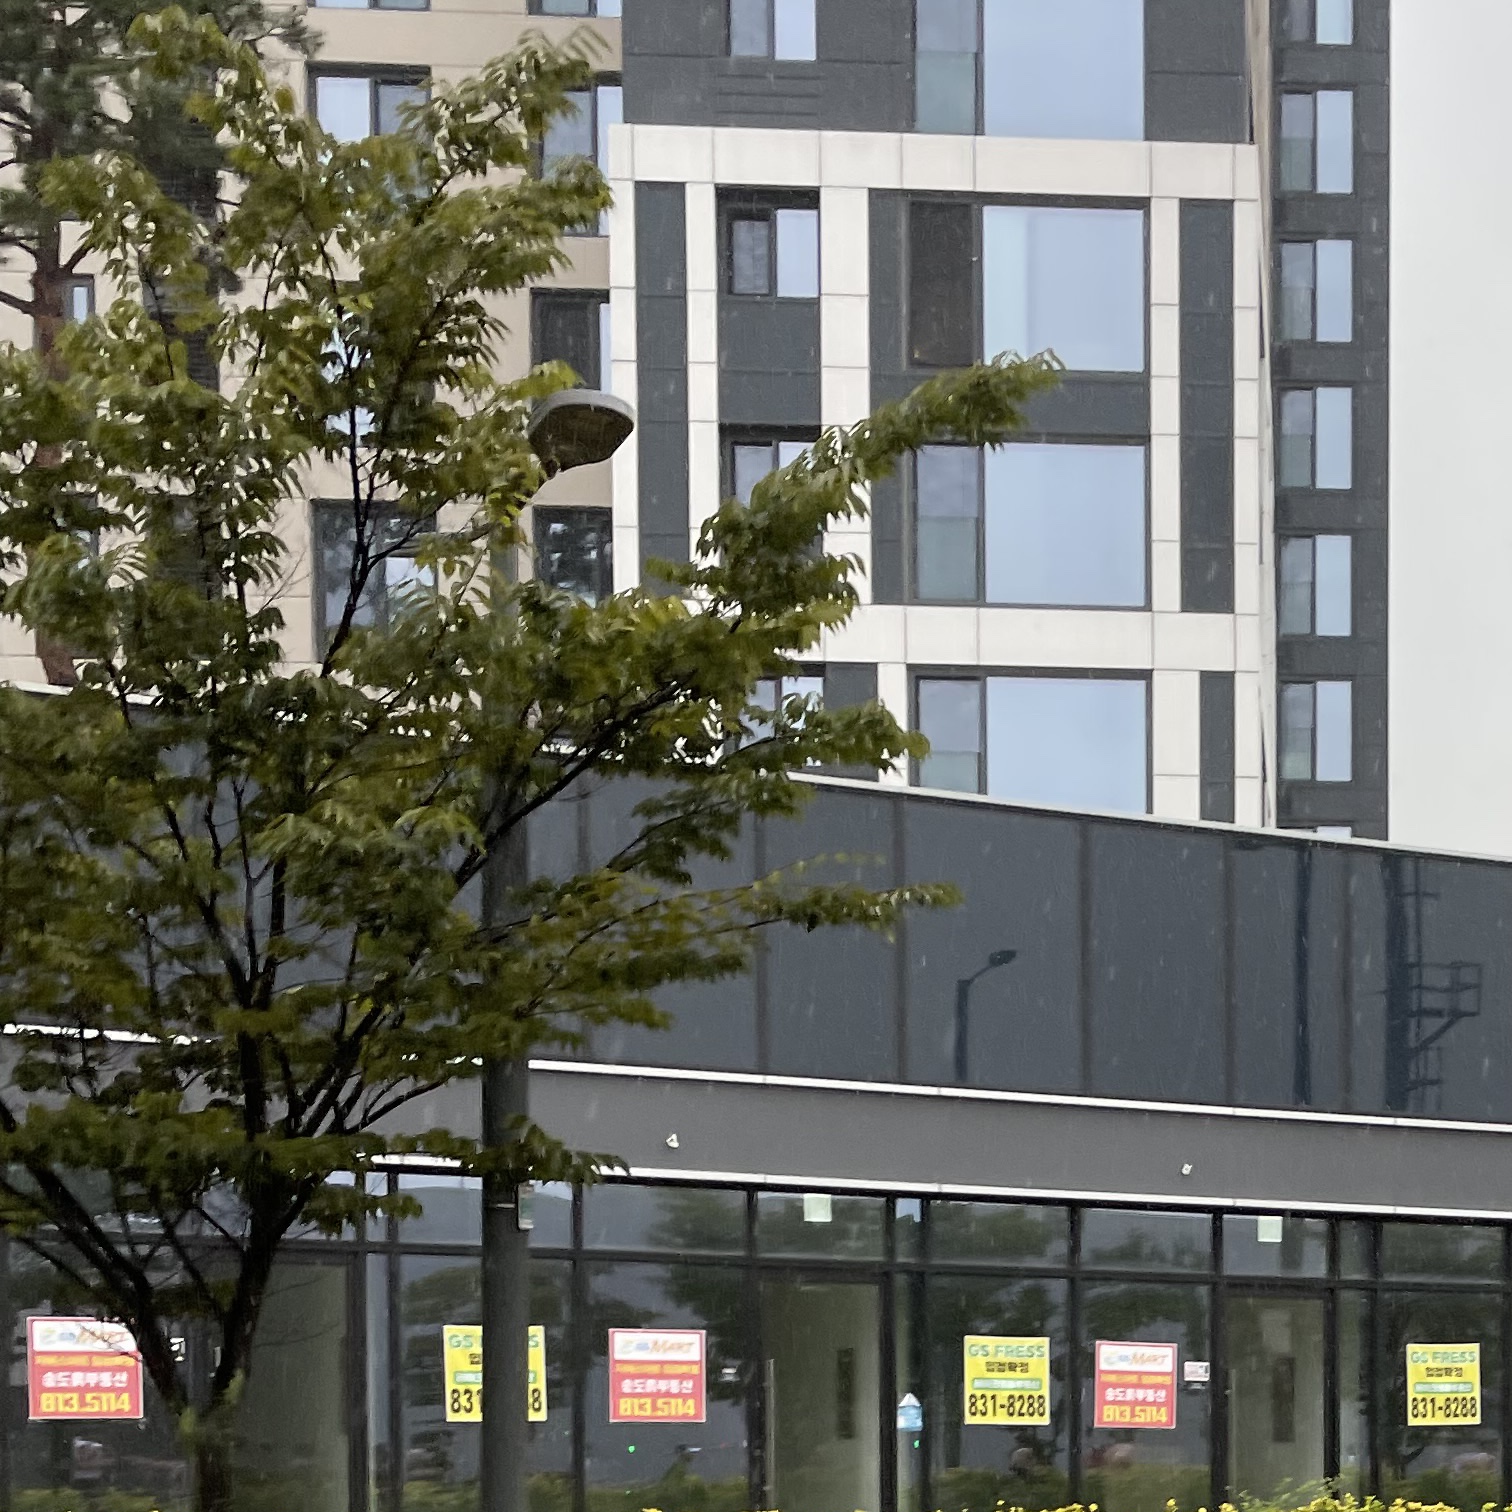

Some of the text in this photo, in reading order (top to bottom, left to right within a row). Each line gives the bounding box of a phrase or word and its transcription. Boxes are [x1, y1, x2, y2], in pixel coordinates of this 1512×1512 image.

[969, 1344, 989, 1357] GS
[968, 1393, 1046, 1417] 831-8288
[1412, 1397, 1477, 1418] 831-8288
